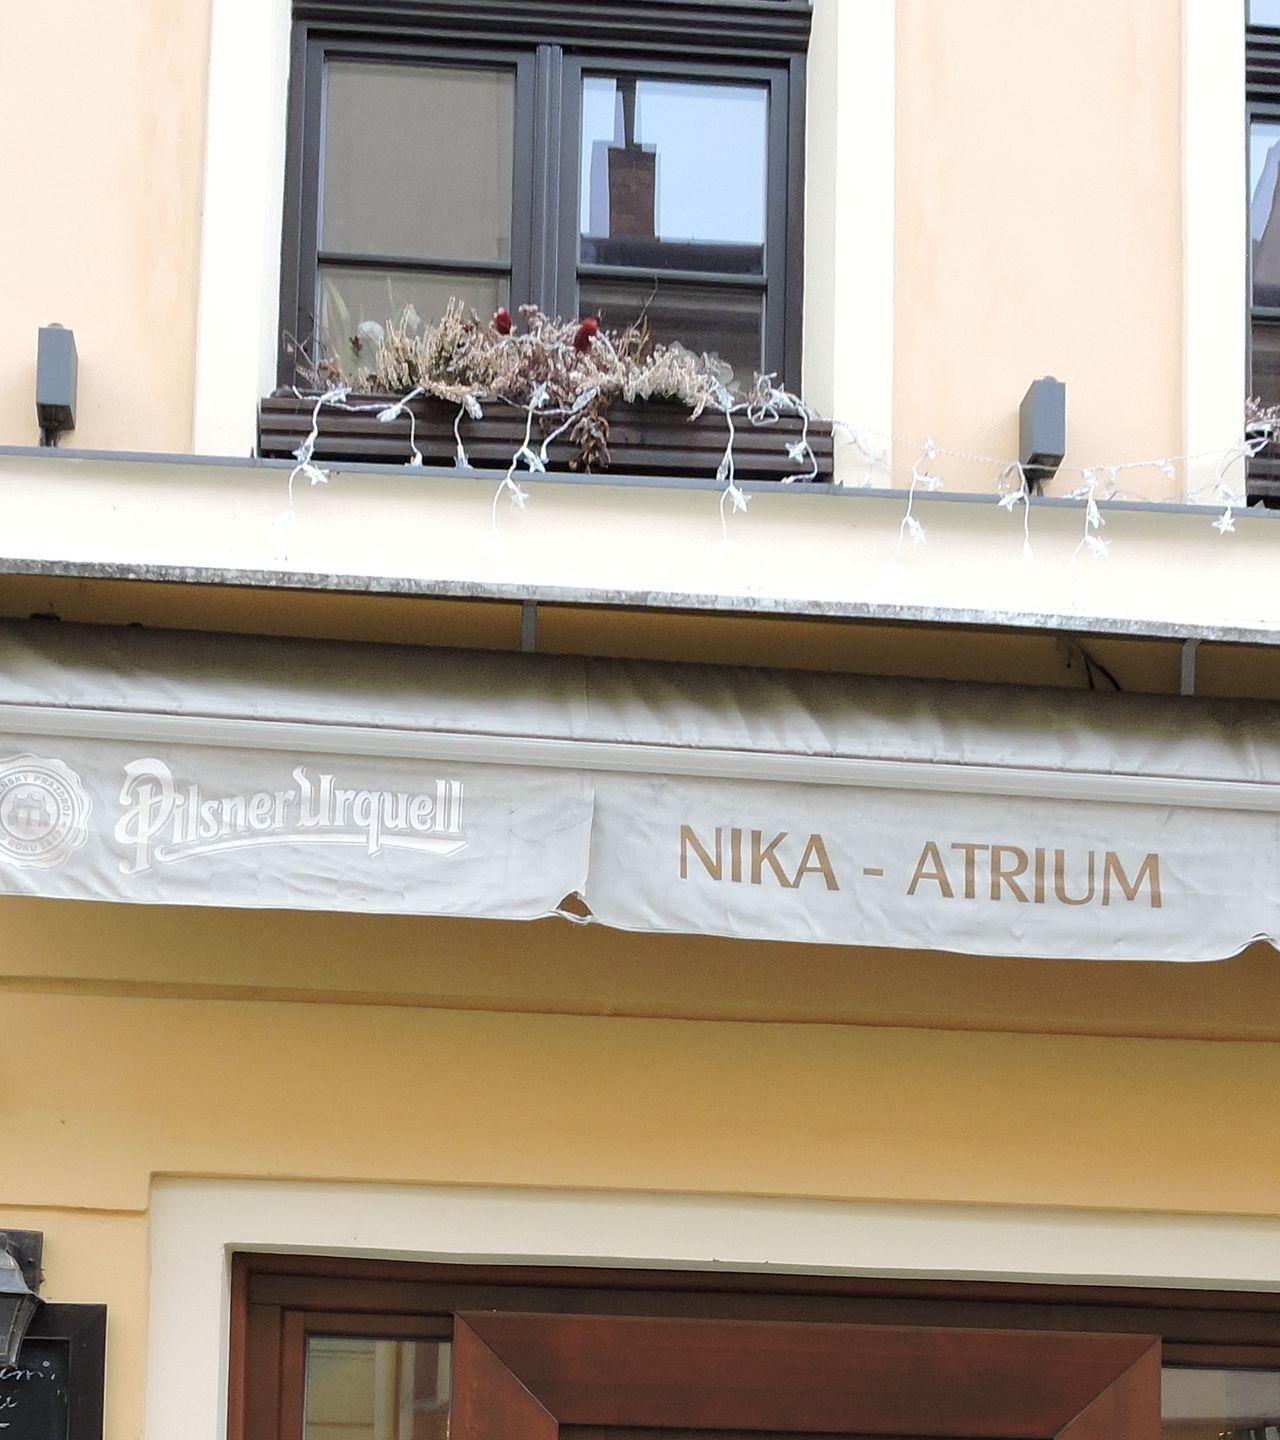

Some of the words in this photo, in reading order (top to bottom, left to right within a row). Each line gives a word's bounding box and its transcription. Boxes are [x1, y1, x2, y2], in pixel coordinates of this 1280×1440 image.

[114, 756, 297, 875] Pilsner
[292, 765, 465, 857] Urquell
[679, 824, 841, 892] NIKA
[863, 867, 884, 877] -
[906, 840, 1163, 909] ATRIUM
